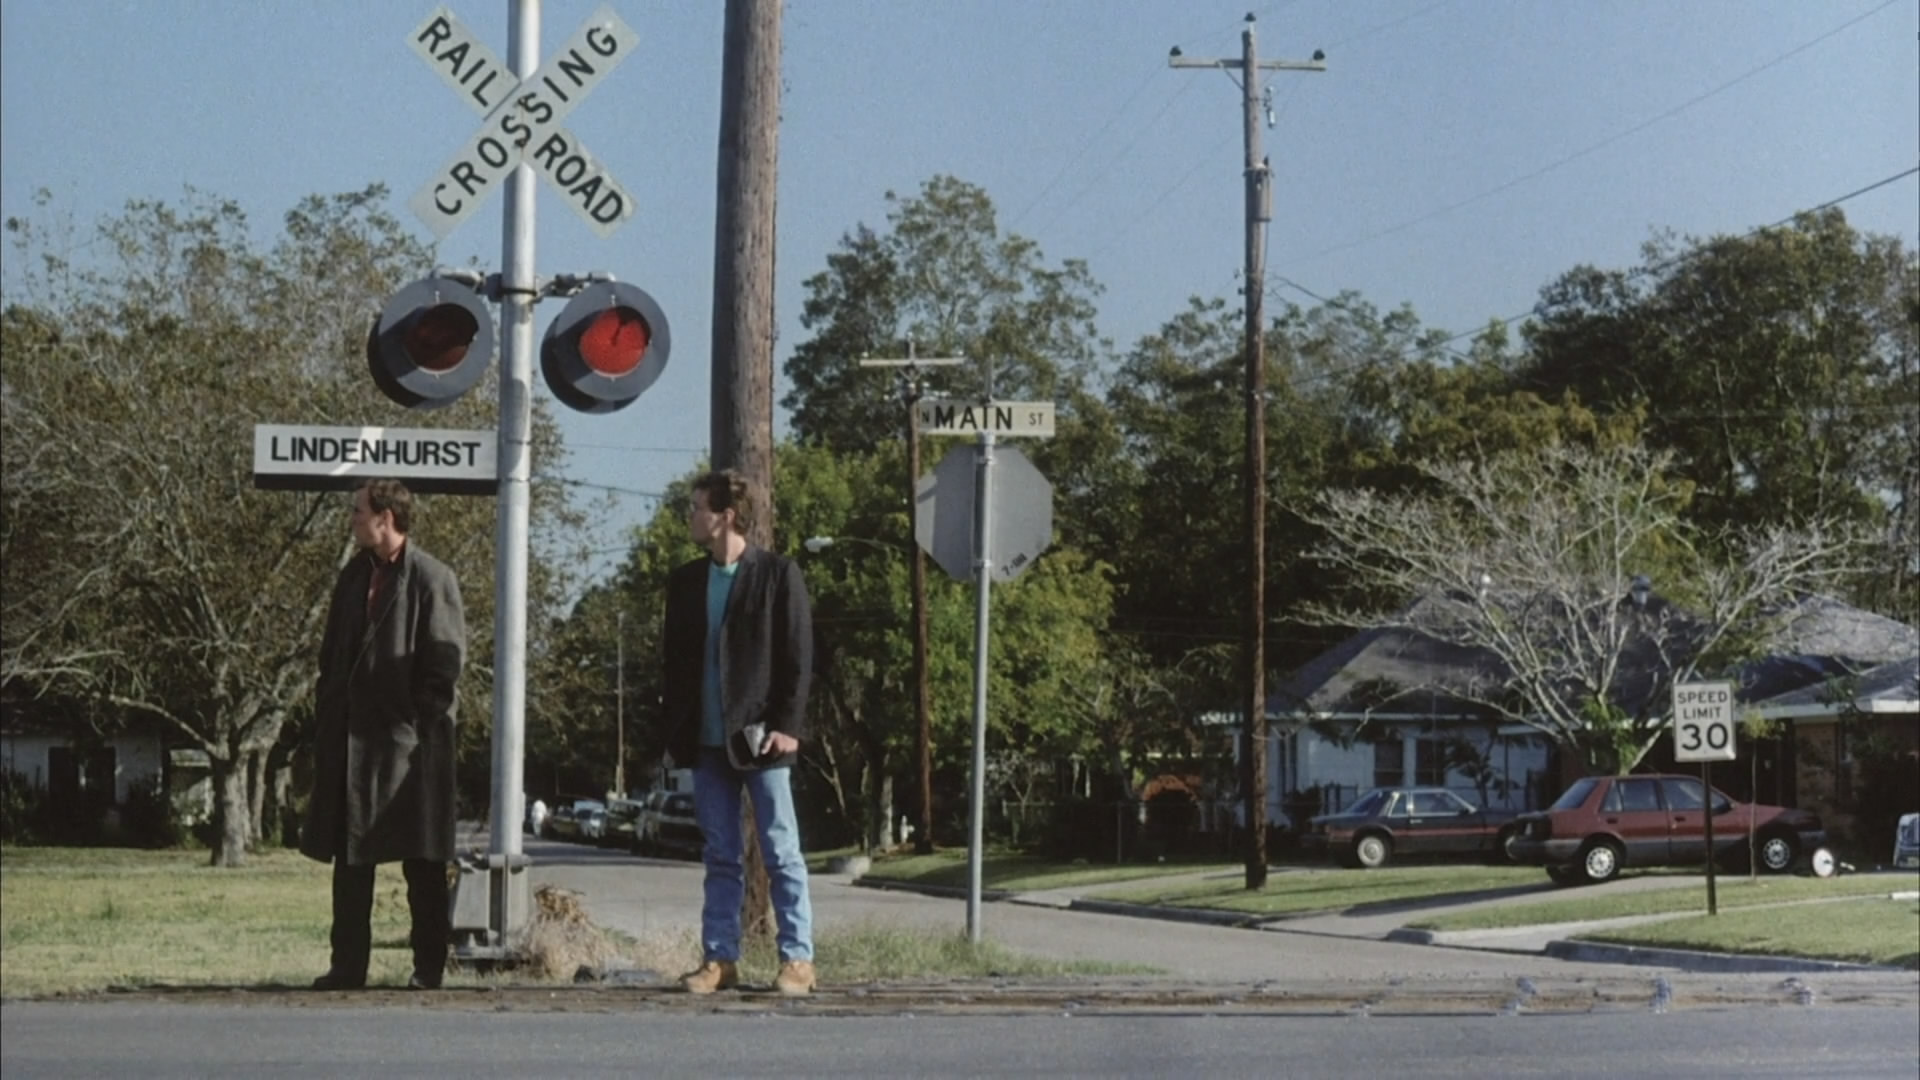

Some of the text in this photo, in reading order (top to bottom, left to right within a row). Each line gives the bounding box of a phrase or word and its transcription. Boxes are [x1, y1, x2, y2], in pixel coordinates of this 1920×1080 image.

[417, 16, 623, 224] RAIL ROAD
[434, 26, 617, 215] CROSSING
[921, 405, 1044, 430] N MAIN ST
[271, 436, 481, 467] LINDENHURST
[1677, 691, 1728, 704] SPEED
[1682, 706, 1721, 719] LIMIT
[1682, 722, 1728, 751] 30
